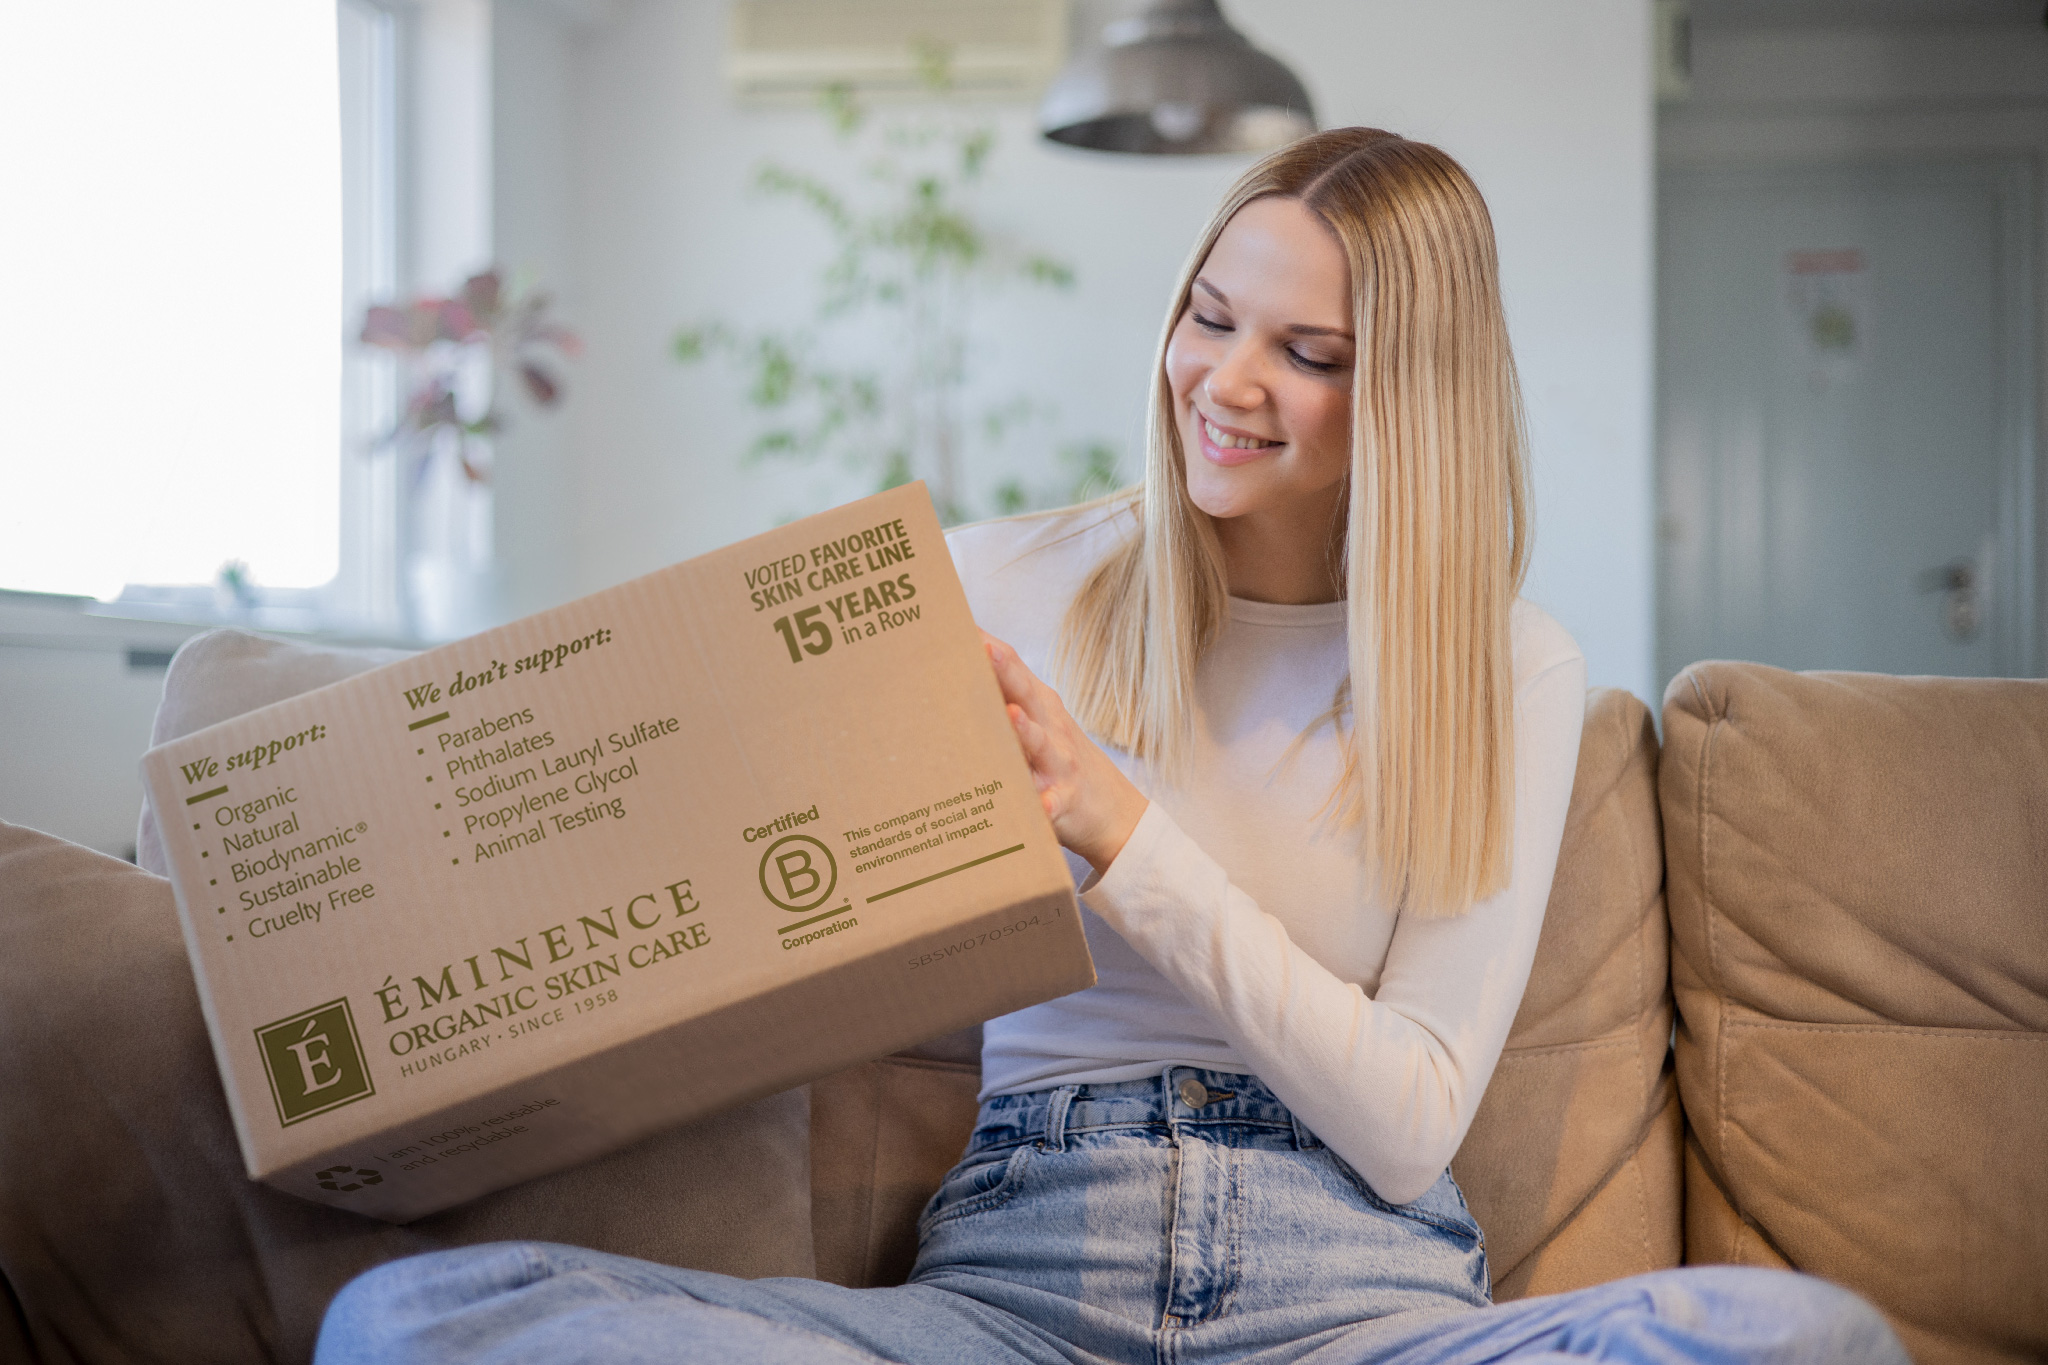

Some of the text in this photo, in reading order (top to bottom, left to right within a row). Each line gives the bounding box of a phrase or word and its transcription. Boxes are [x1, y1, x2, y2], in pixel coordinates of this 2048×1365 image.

[744, 519, 907, 589] VOTED FAVORITE
[751, 539, 915, 611] SKIN CARE LINE
[773, 574, 916, 663] 15 YEARS
[841, 605, 920, 644] in a Row
[403, 629, 611, 710] We don’t support:
[180, 725, 325, 784] We support:
[438, 709, 534, 752] Parabens
[447, 732, 554, 779] Phthalates
[456, 718, 679, 807] Sodium Lauryl Sulfate
[215, 787, 297, 826] Organic
[464, 757, 638, 834] Propylene Glycol
[743, 805, 819, 842] Certified
[843, 780, 1002, 842] This company meets high
[223, 812, 299, 855] Natural
[476, 798, 625, 862] Animal Testing
[850, 799, 994, 858] standards of social and
[856, 819, 993, 873] environmental impact.
[240, 856, 361, 911] Sustainable
[775, 850, 820, 899] B
[249, 884, 374, 937] Cruelty Free
[782, 918, 858, 950] Corporation
[374, 879, 699, 1023] ÉMINENCE
[390, 923, 710, 1055] ORGANIC SKIN CARE
[287, 1020, 341, 1095] É
[401, 990, 618, 1077] HUNGARY SINCE 1958
[388, 1144, 422, 1160] am
[419, 1125, 480, 1147] 100%
[481, 1097, 560, 1127] reusable
[400, 1124, 528, 1171] and recyclable
